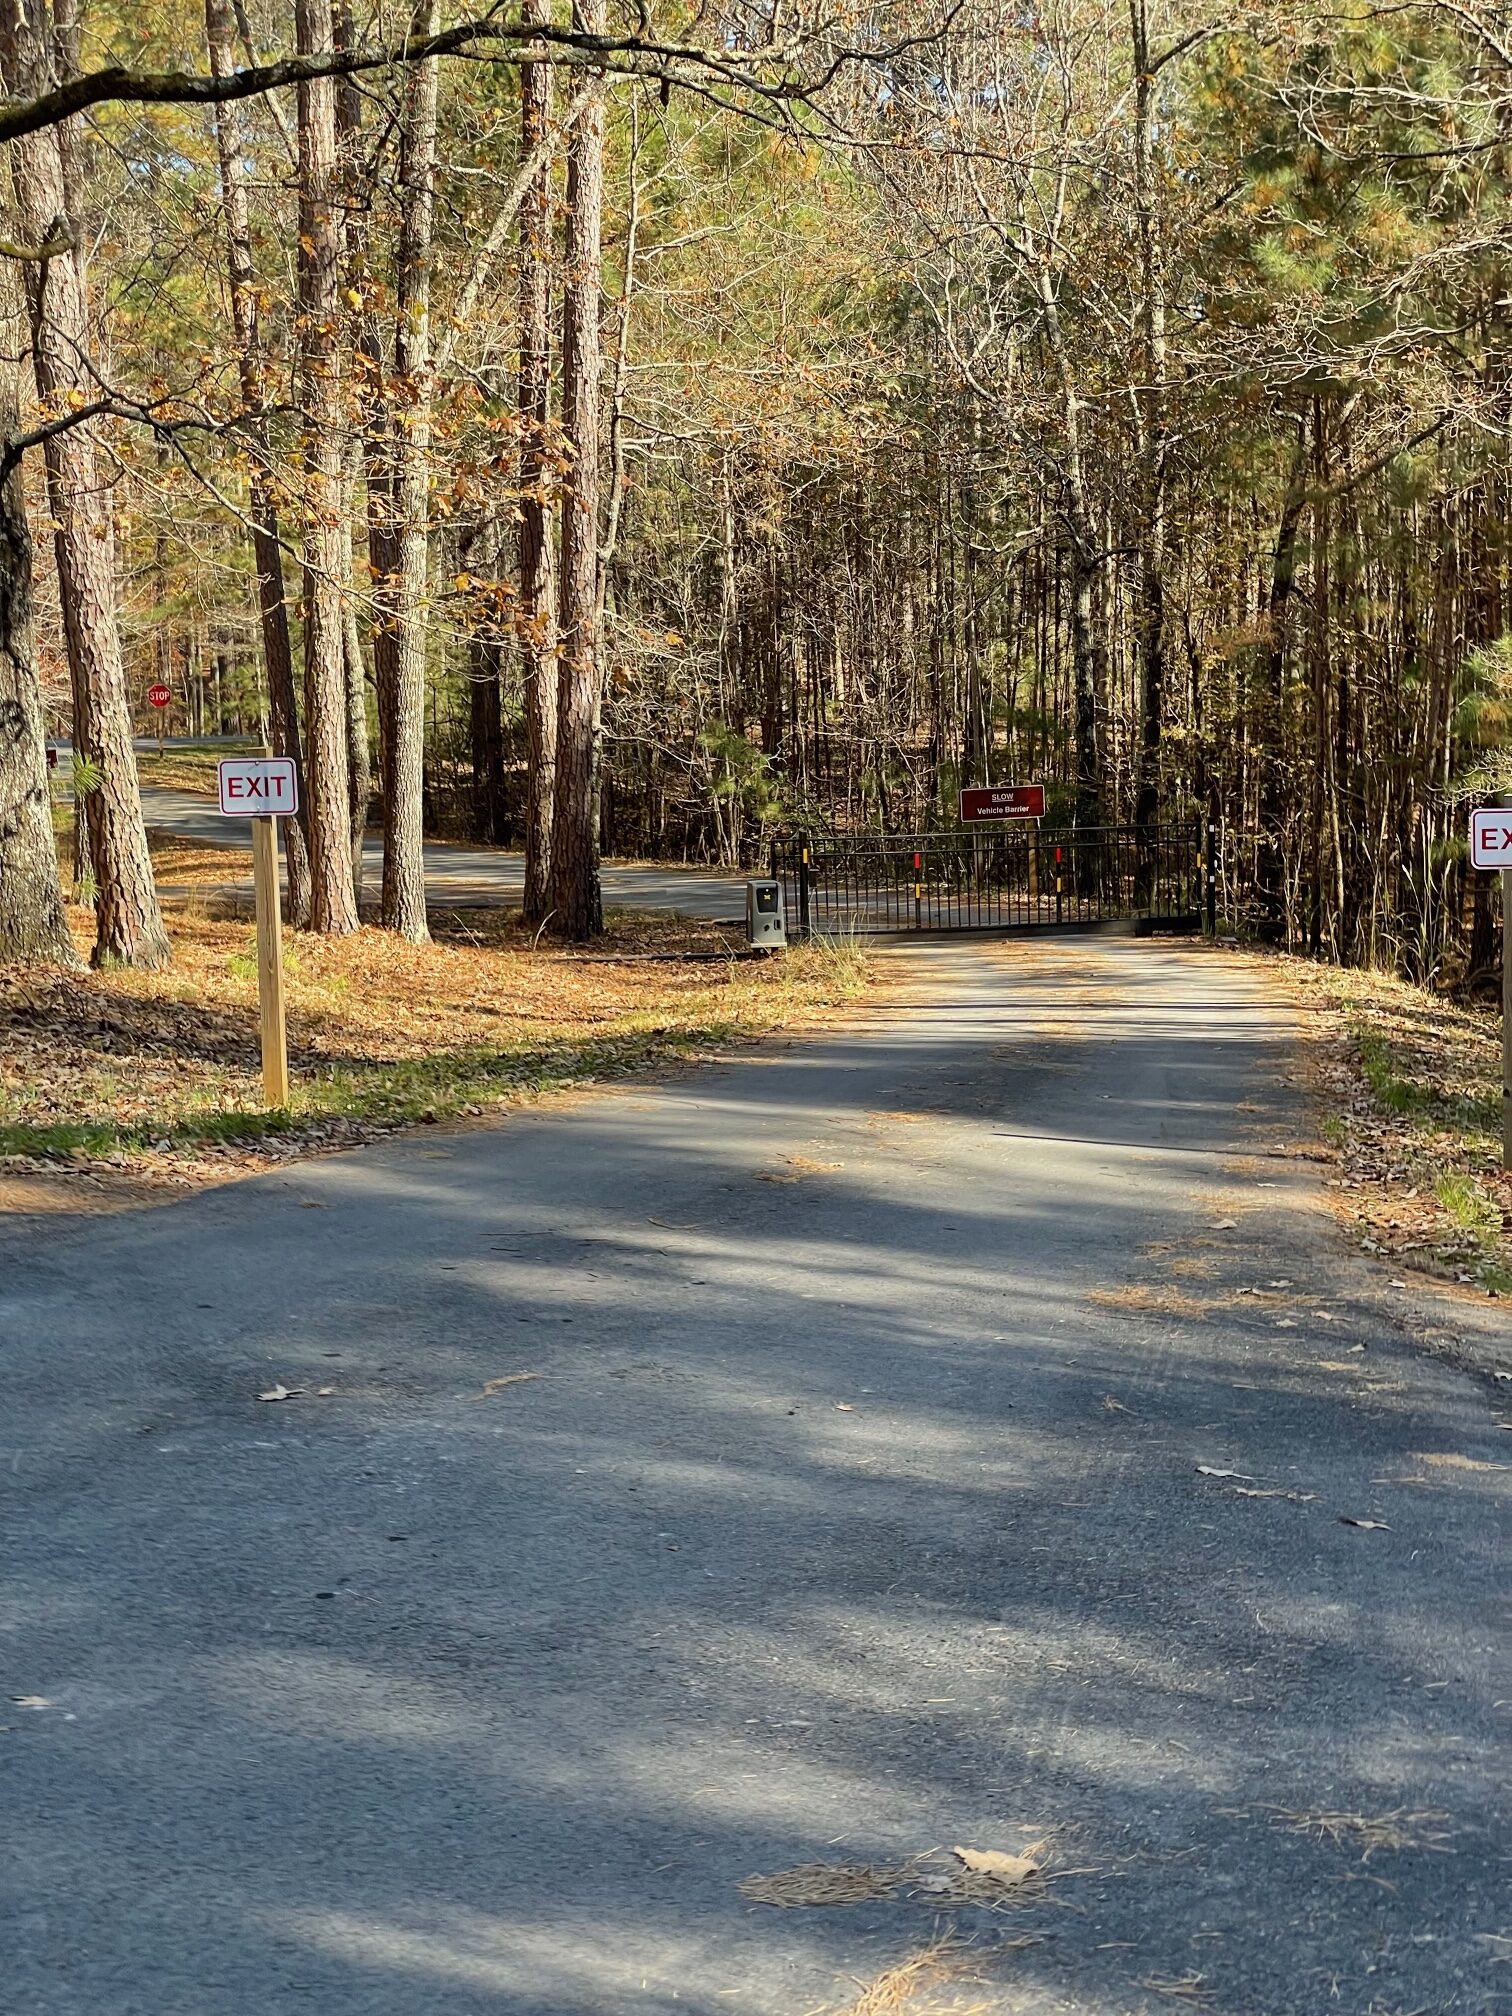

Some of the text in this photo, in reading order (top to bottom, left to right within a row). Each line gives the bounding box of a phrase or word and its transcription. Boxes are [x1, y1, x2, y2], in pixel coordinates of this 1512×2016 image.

[150, 691, 170, 701] STOP
[228, 776, 287, 798] EXIT
[991, 793, 1014, 801] SLOW
[977, 805, 1030, 815] Vehicle Barrier
